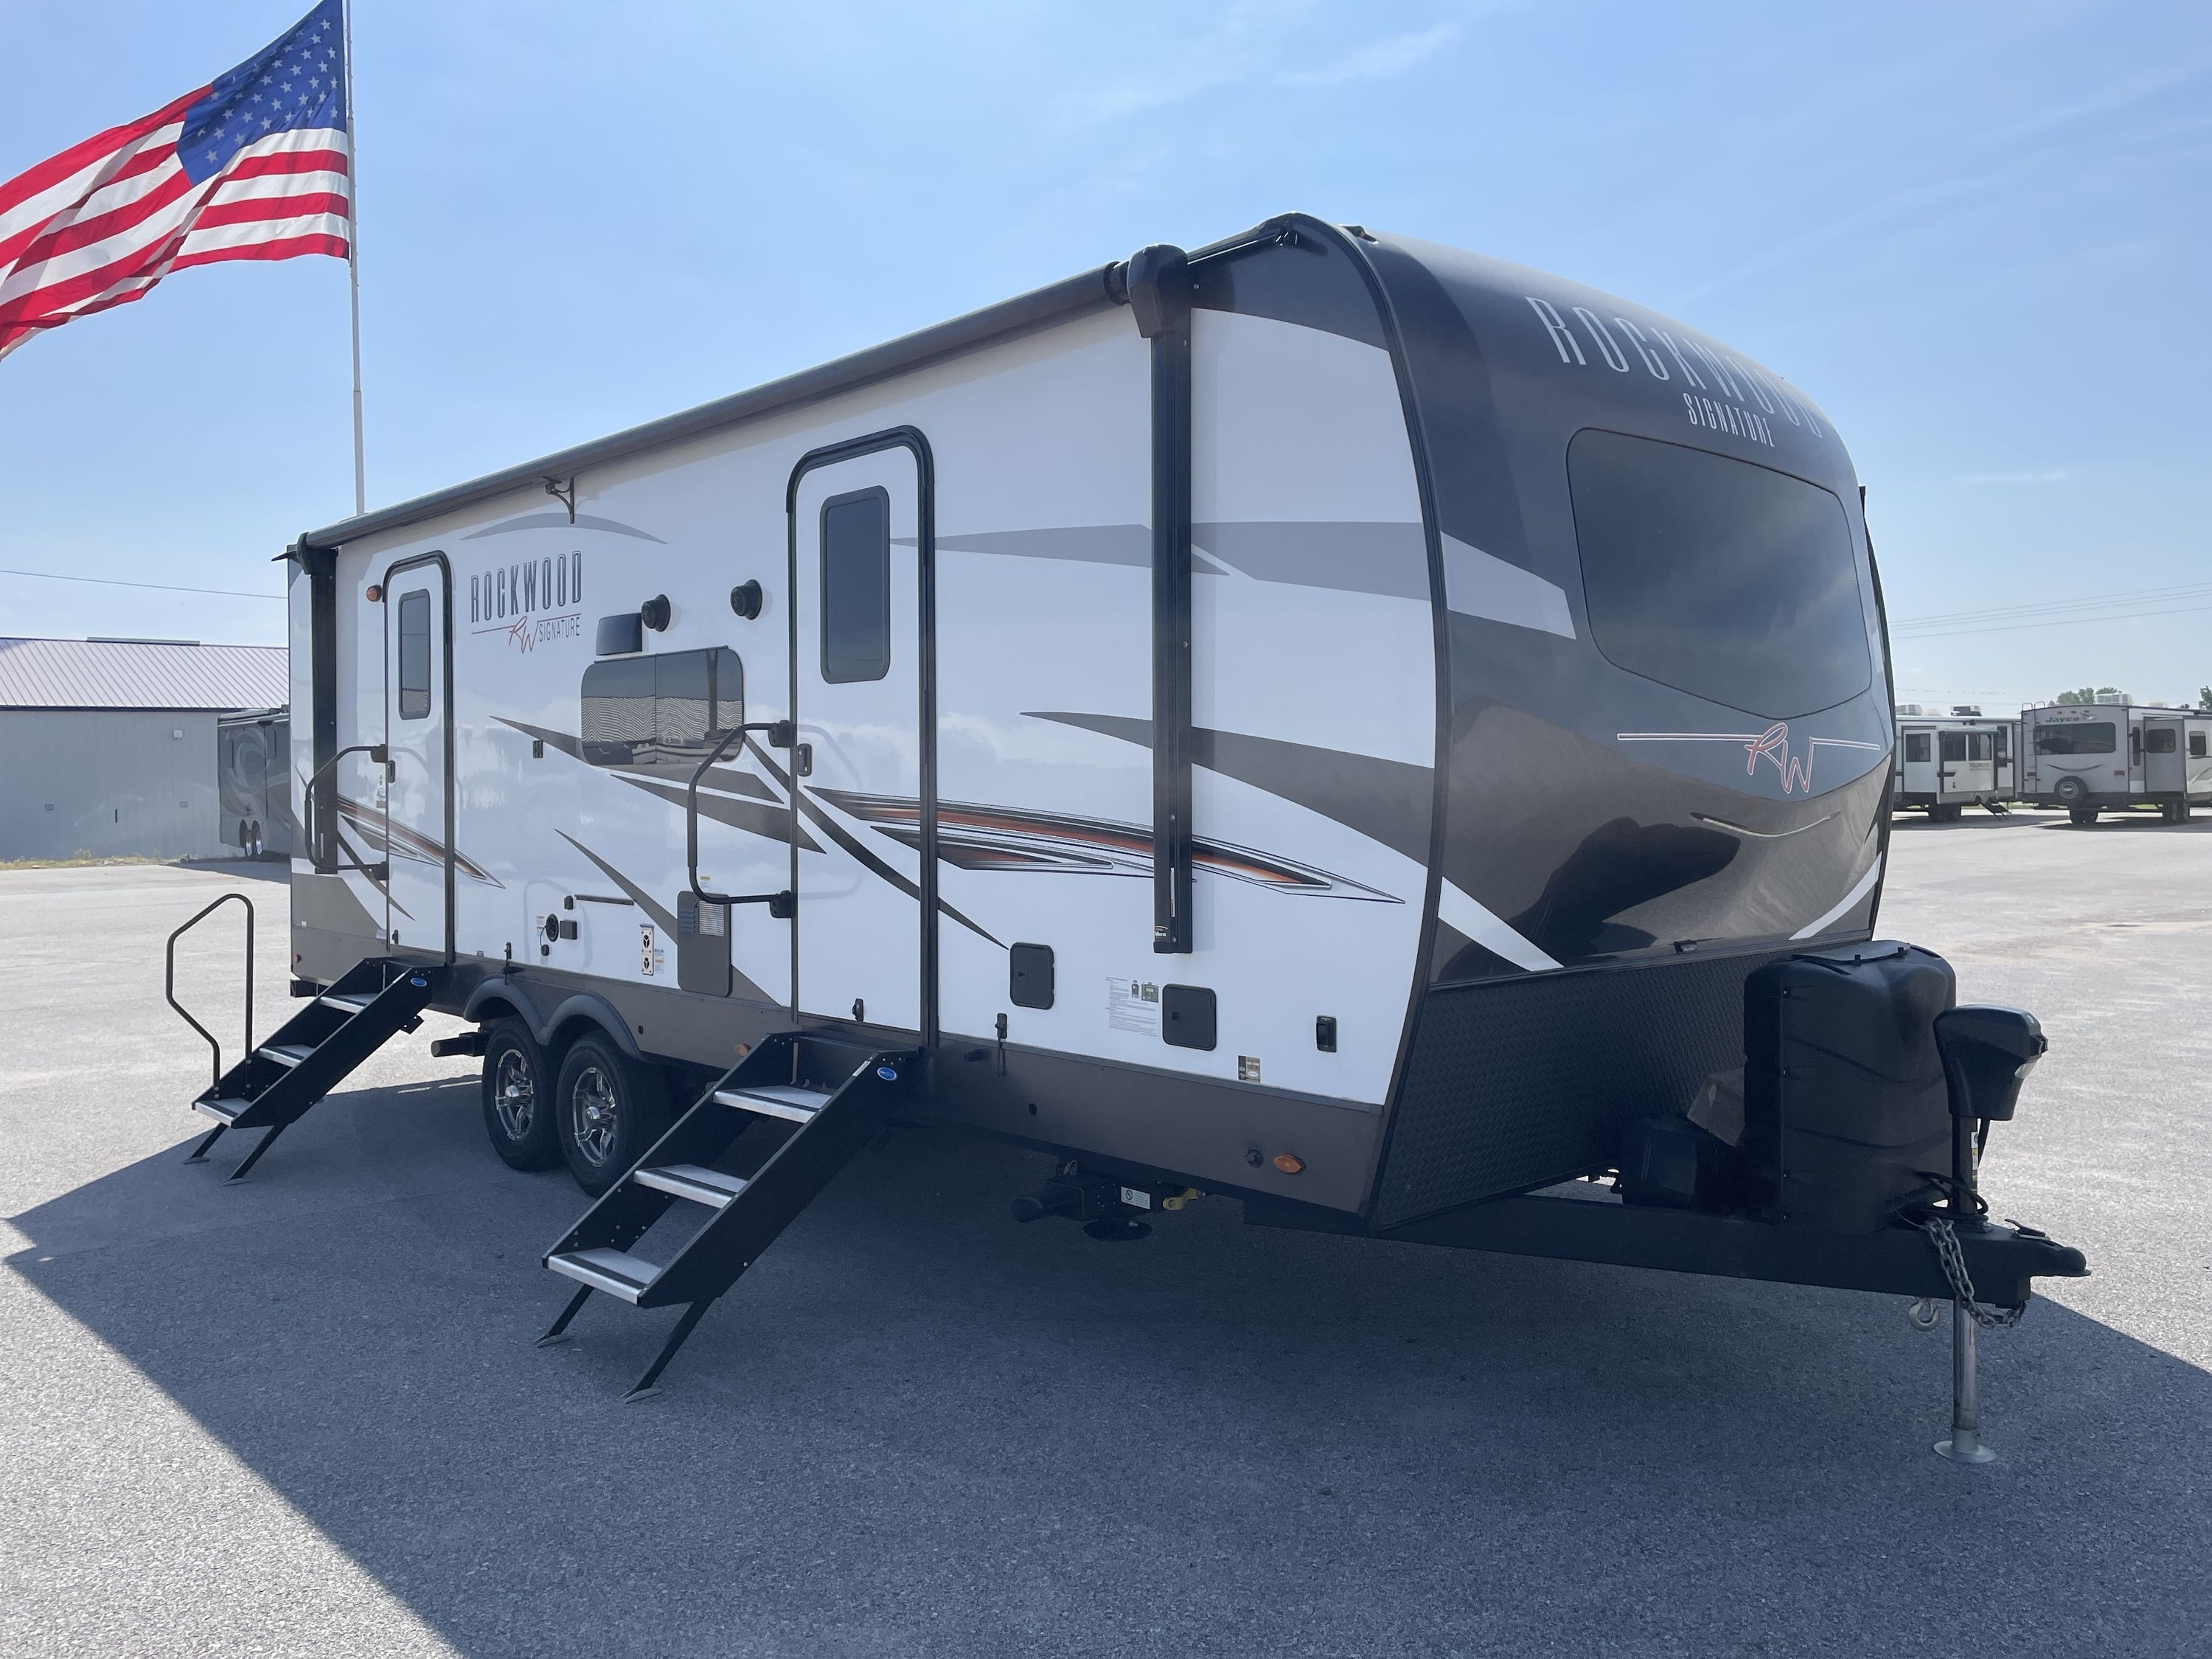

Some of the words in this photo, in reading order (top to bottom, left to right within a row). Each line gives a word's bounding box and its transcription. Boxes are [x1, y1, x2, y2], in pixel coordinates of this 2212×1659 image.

[1525, 296, 1823, 439] ROCKWOOD
[1683, 392, 1775, 448] SIGNATURE
[471, 550, 582, 623] ROCKWOOD
[539, 616, 580, 642] SIGNATURE
